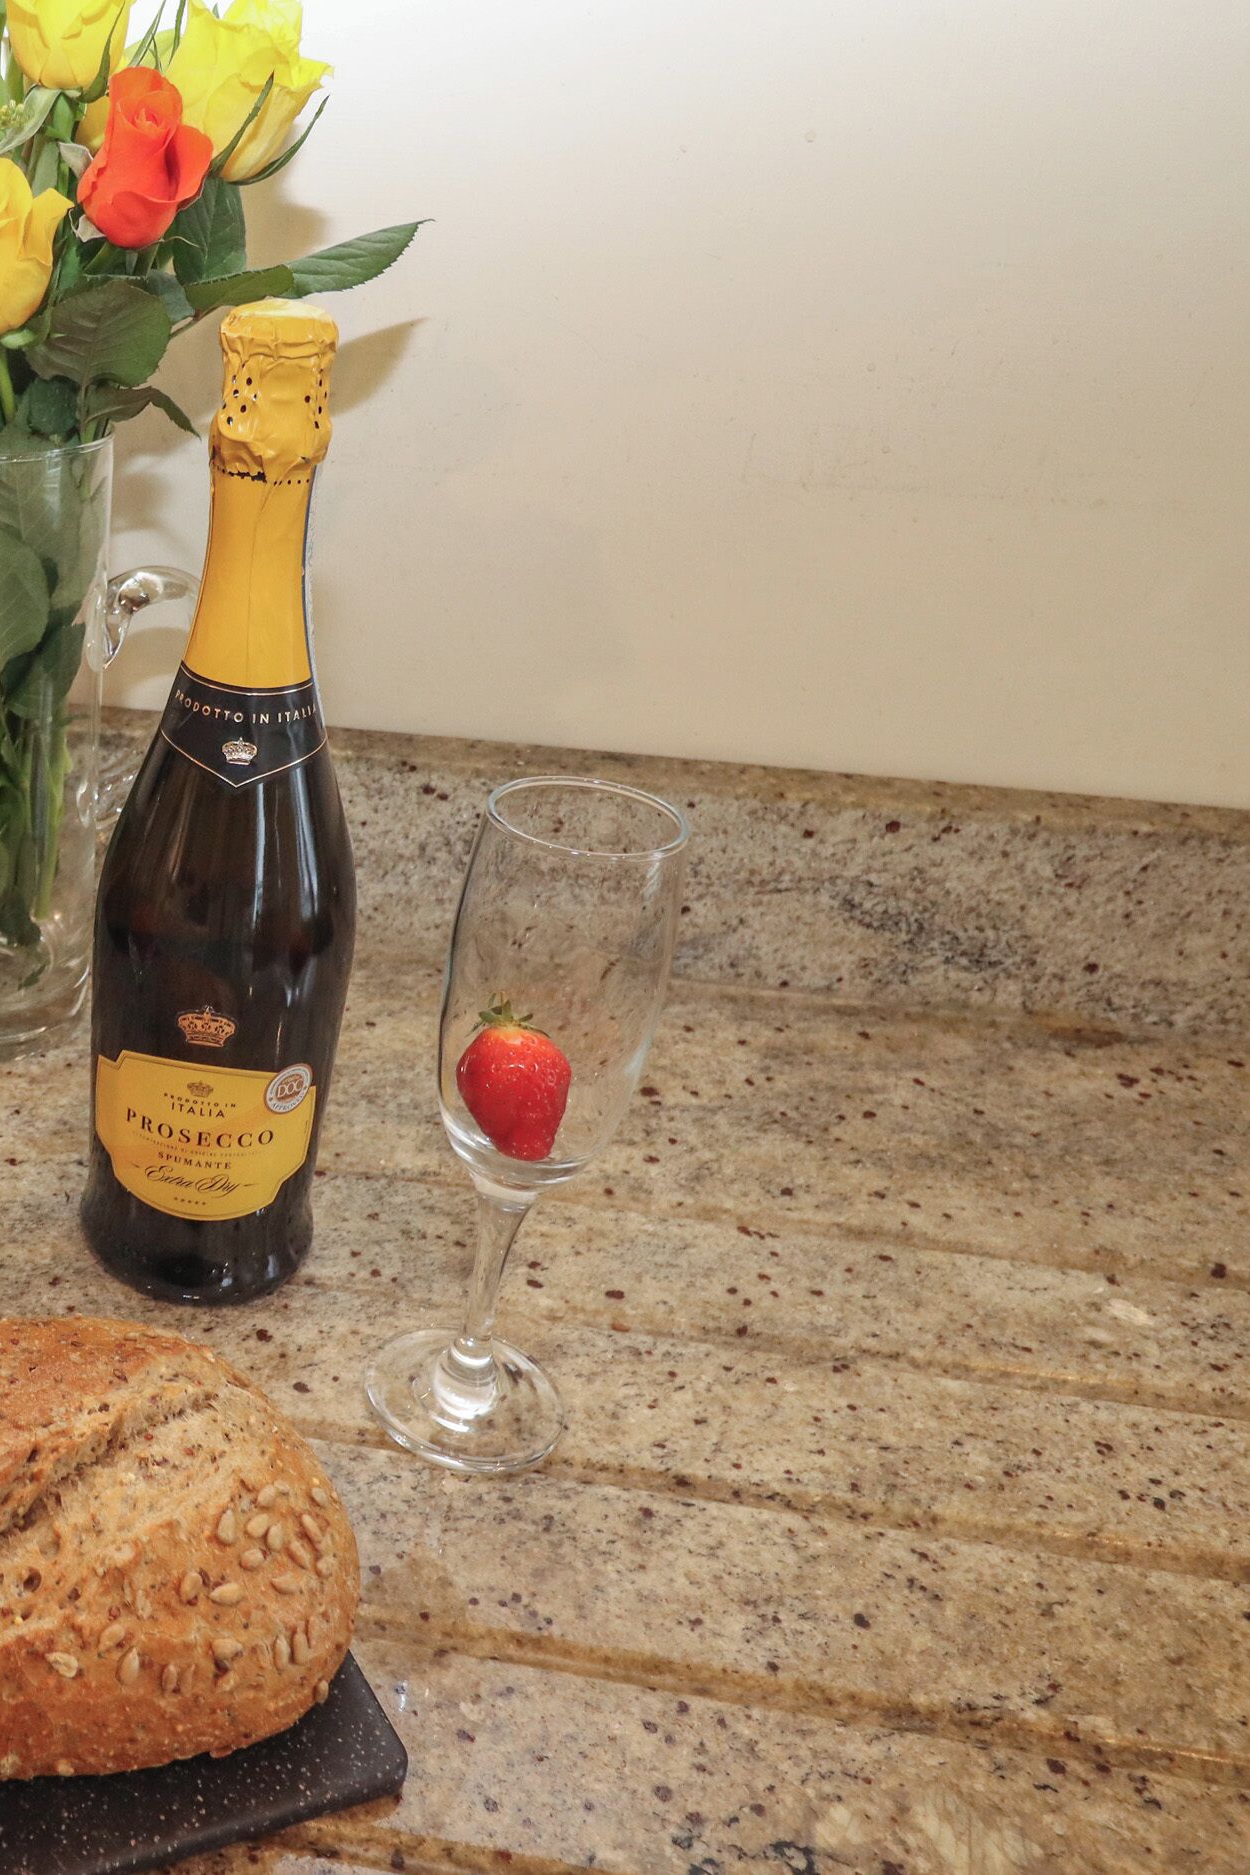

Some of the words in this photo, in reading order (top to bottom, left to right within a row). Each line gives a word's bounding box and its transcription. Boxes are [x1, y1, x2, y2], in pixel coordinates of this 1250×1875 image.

[175, 689, 244, 723] PRODOTTO
[252, 713, 270, 724] IN
[278, 703, 317, 723] ITALIA
[277, 1078, 303, 1098] DOC
[171, 1102, 225, 1118] ITALIA
[126, 1107, 274, 1149] PROSECCO
[158, 1151, 232, 1170] SPUMANTE
[145, 1165, 194, 1188] Extra
[194, 1174, 240, 1198] Dry
